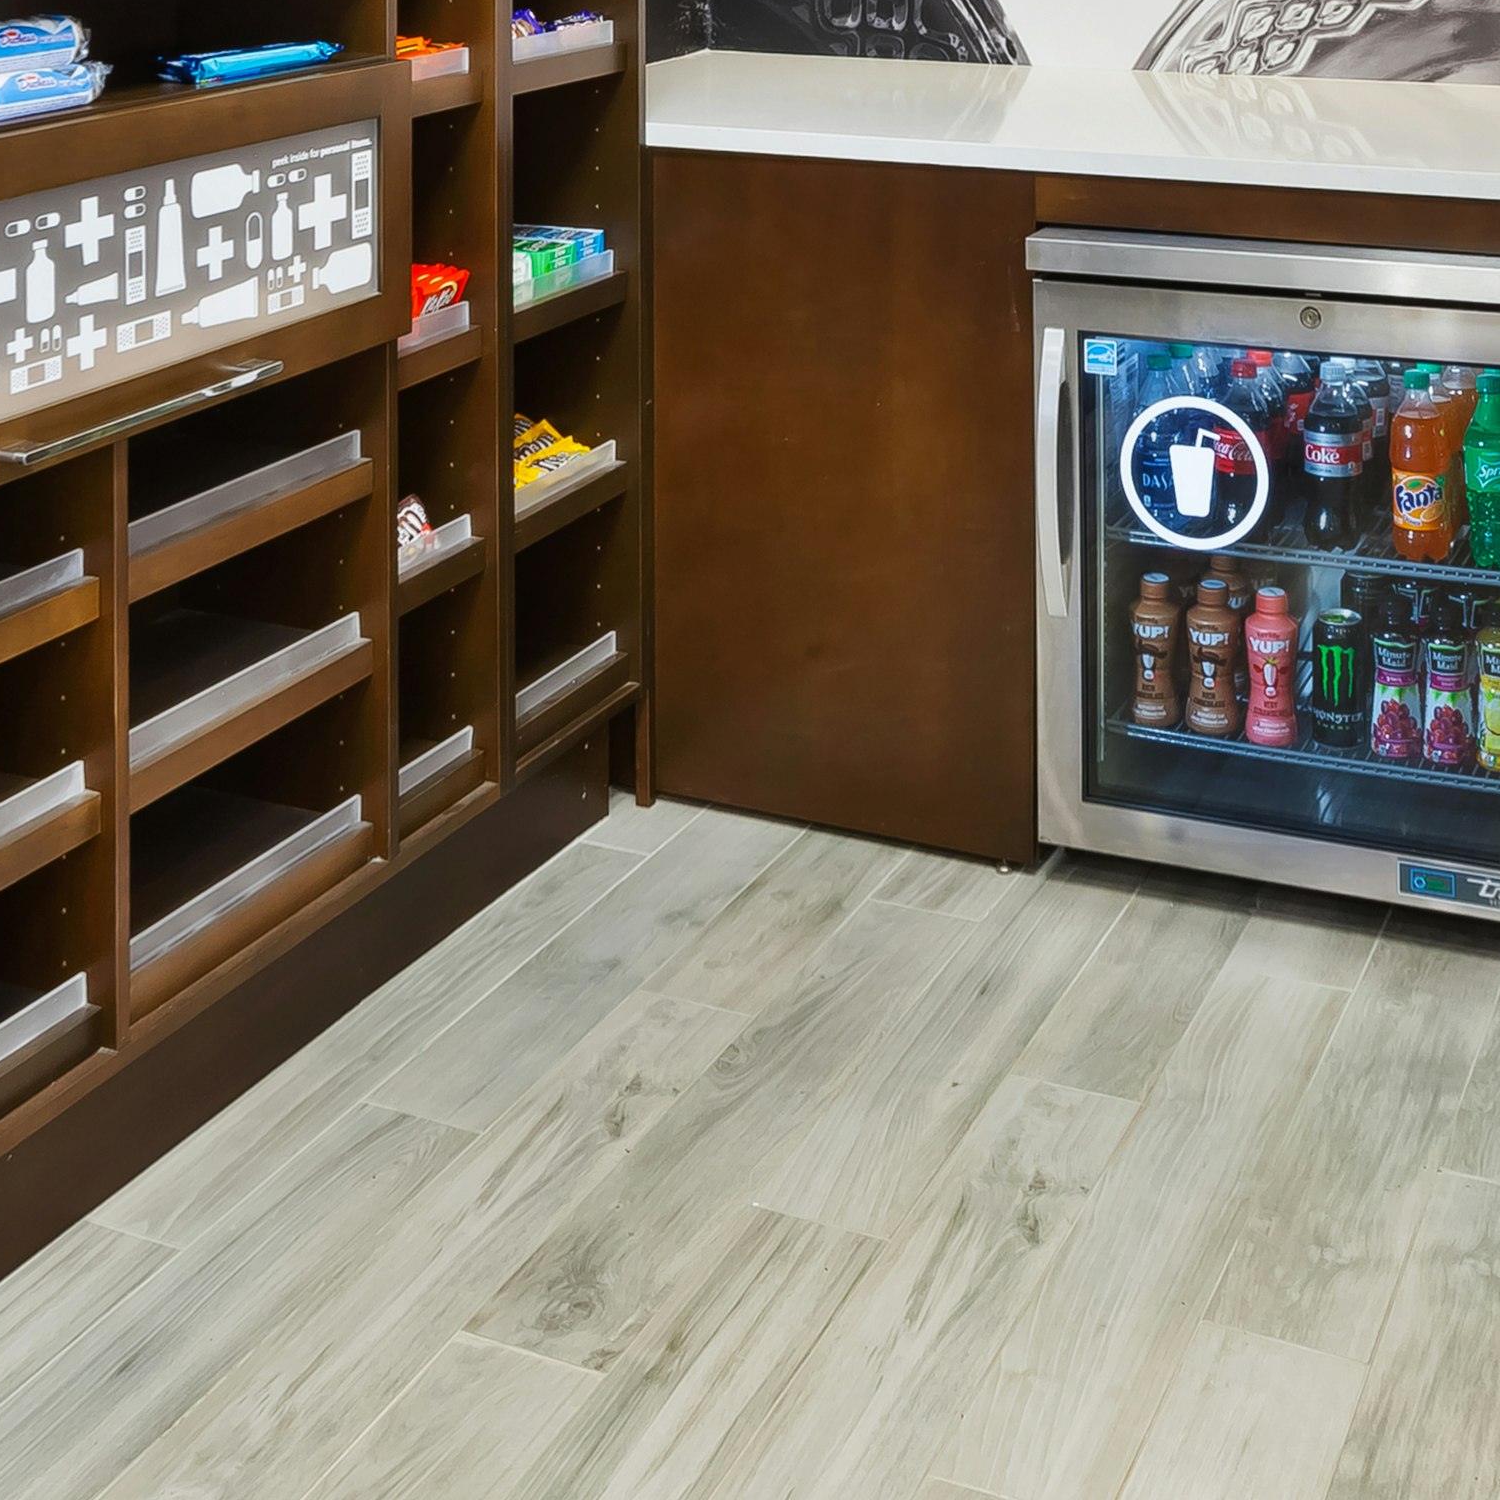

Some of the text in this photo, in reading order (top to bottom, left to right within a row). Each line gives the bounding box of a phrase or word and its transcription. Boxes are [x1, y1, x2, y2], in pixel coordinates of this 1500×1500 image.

[1305, 443, 1341, 465] Coke
[1395, 484, 1443, 514] Fanta
[1134, 623, 1170, 639] YUP!
[1189, 628, 1230, 646] YUP!
[1249, 636, 1290, 654] YUP!
